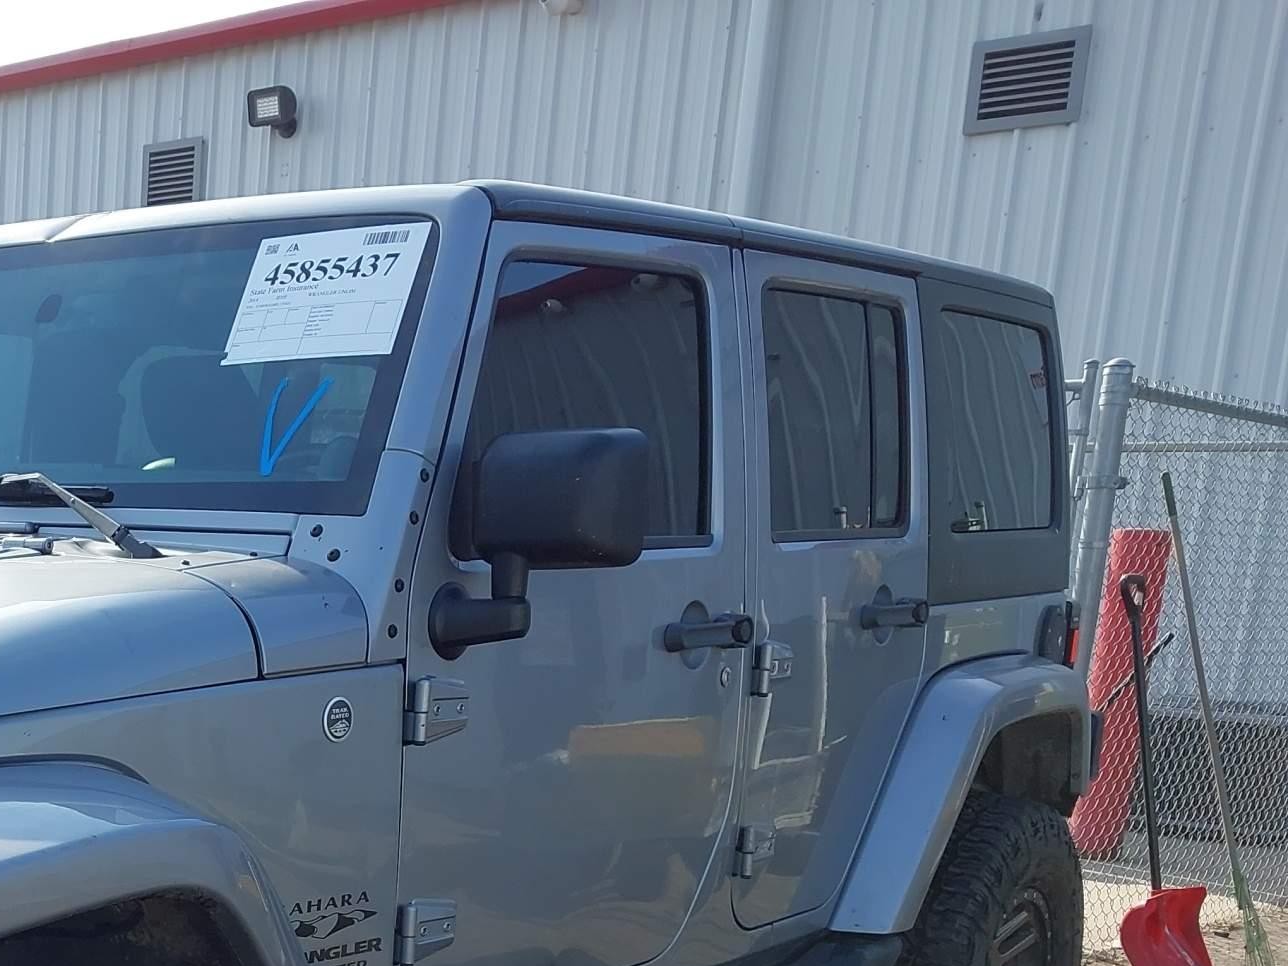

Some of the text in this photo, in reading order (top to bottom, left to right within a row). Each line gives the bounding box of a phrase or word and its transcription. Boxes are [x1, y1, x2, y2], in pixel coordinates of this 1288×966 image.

[264, 253, 400, 286] 45855437
[289, 891, 370, 916] AHARA
[304, 937, 383, 964] NGLER
